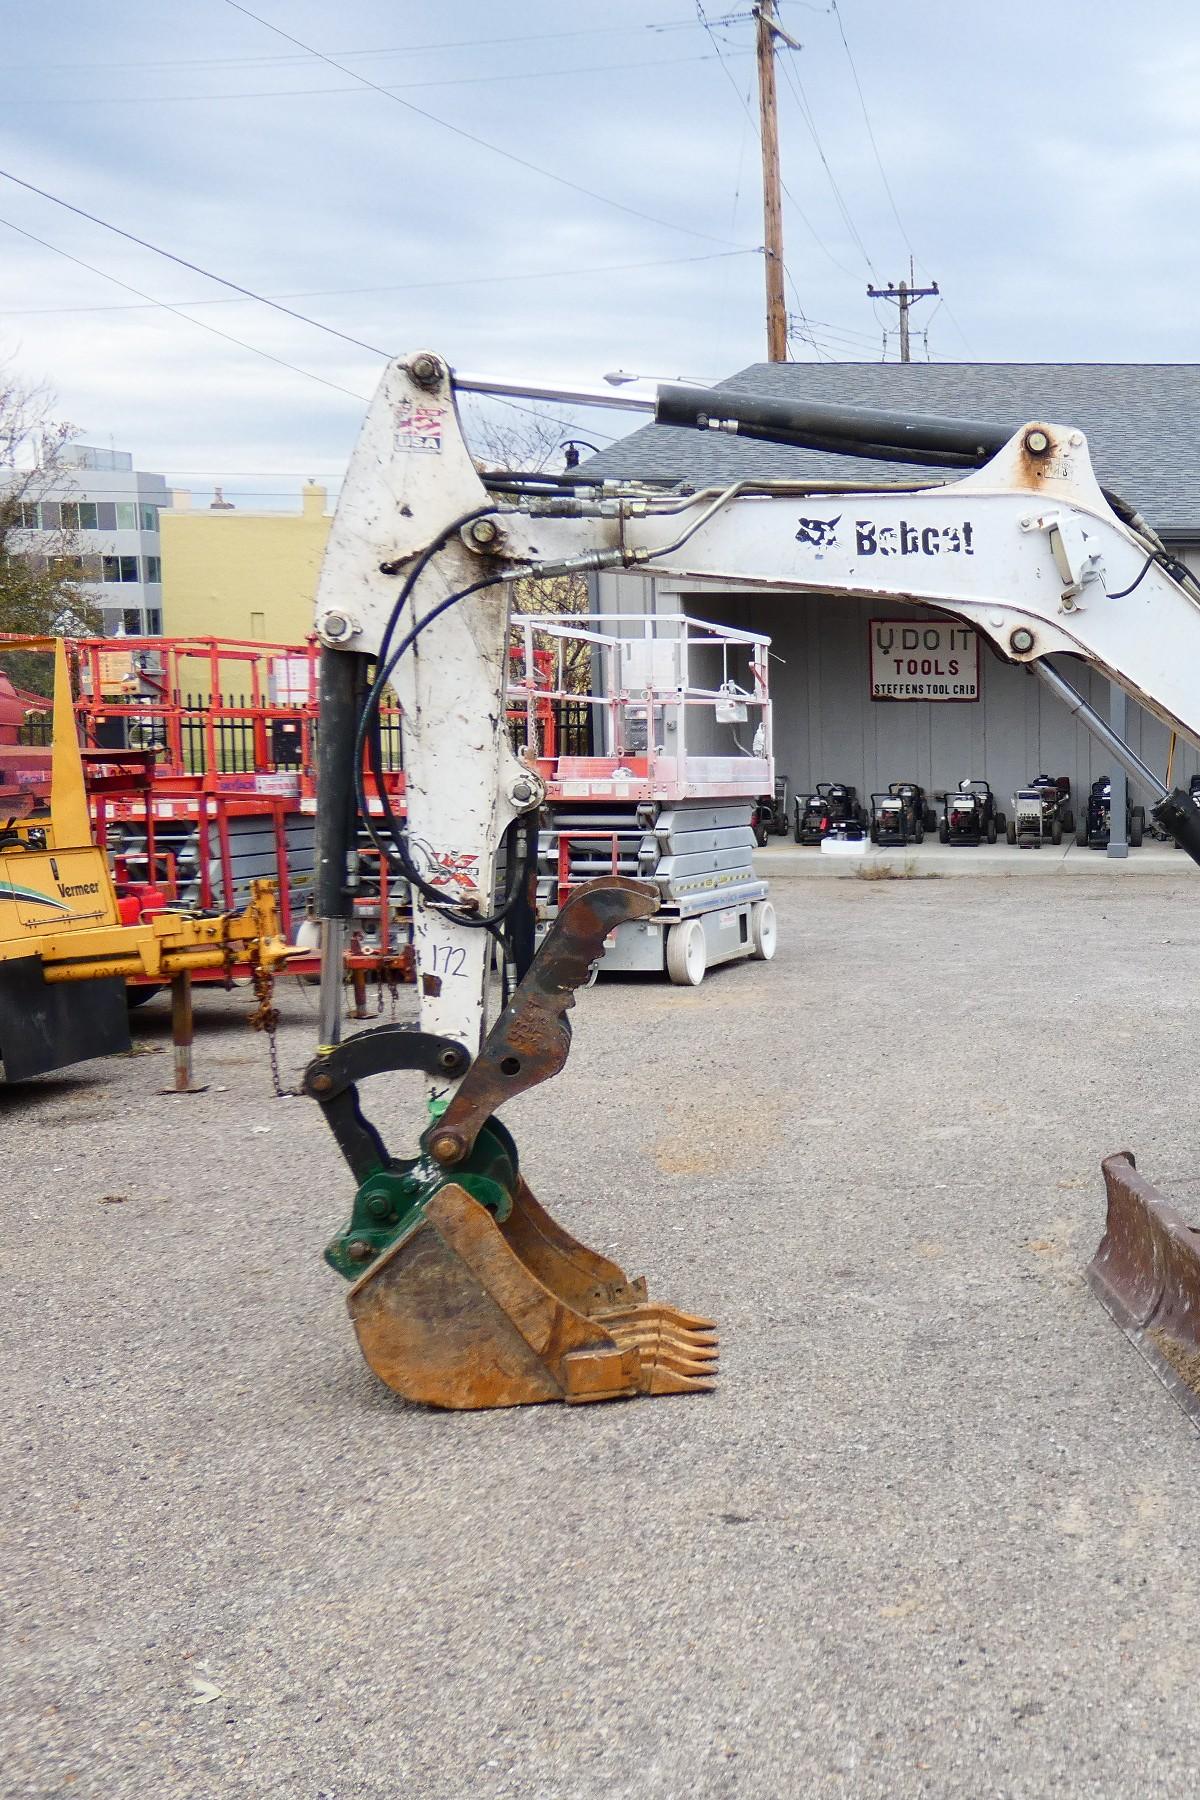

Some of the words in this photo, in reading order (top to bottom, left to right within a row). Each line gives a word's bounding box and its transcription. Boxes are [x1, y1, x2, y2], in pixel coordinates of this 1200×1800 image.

[398, 436, 439, 449] USA
[950, 628, 974, 651] IT
[893, 659, 960, 676] TOOLS
[874, 684, 924, 695] STEFFENS
[926, 684, 951, 695] TOOL
[953, 684, 976, 695] CRIB
[57, 882, 99, 898] Vermeer
[432, 944, 469, 978] 172
